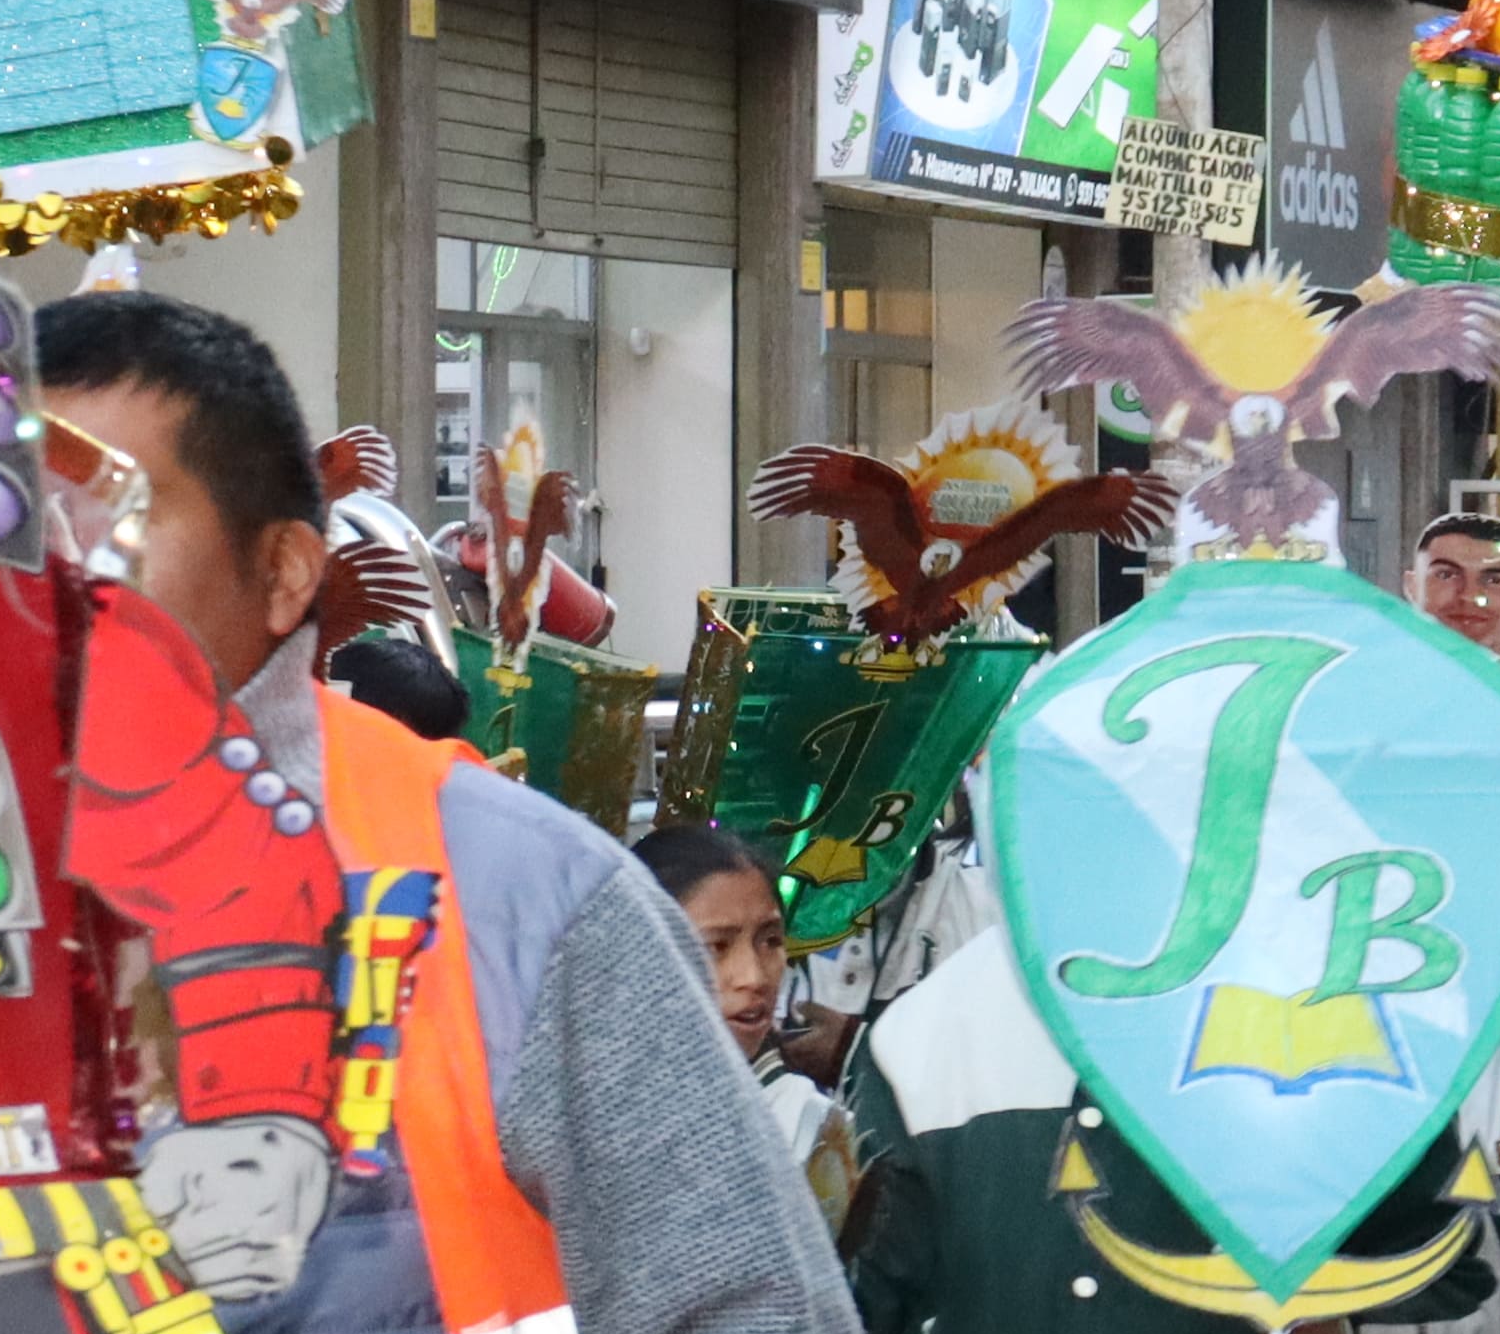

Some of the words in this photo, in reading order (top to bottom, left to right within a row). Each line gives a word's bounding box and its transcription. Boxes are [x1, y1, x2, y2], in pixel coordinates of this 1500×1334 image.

[1124, 123, 1204, 151] ALQUILO
[926, 152, 979, 187] Huancane
[1017, 170, 1061, 201] JULIACA
[1121, 144, 1255, 180] COMPACTADOR
[1116, 166, 1213, 198] MARTILLO
[1280, 150, 1359, 230] adidas
[1119, 210, 1207, 239] TROMPOS
[1121, 189, 1245, 228] 951258585
[850, 791, 918, 849] B
[1057, 631, 1360, 999] J
[1296, 846, 1466, 1008] B
